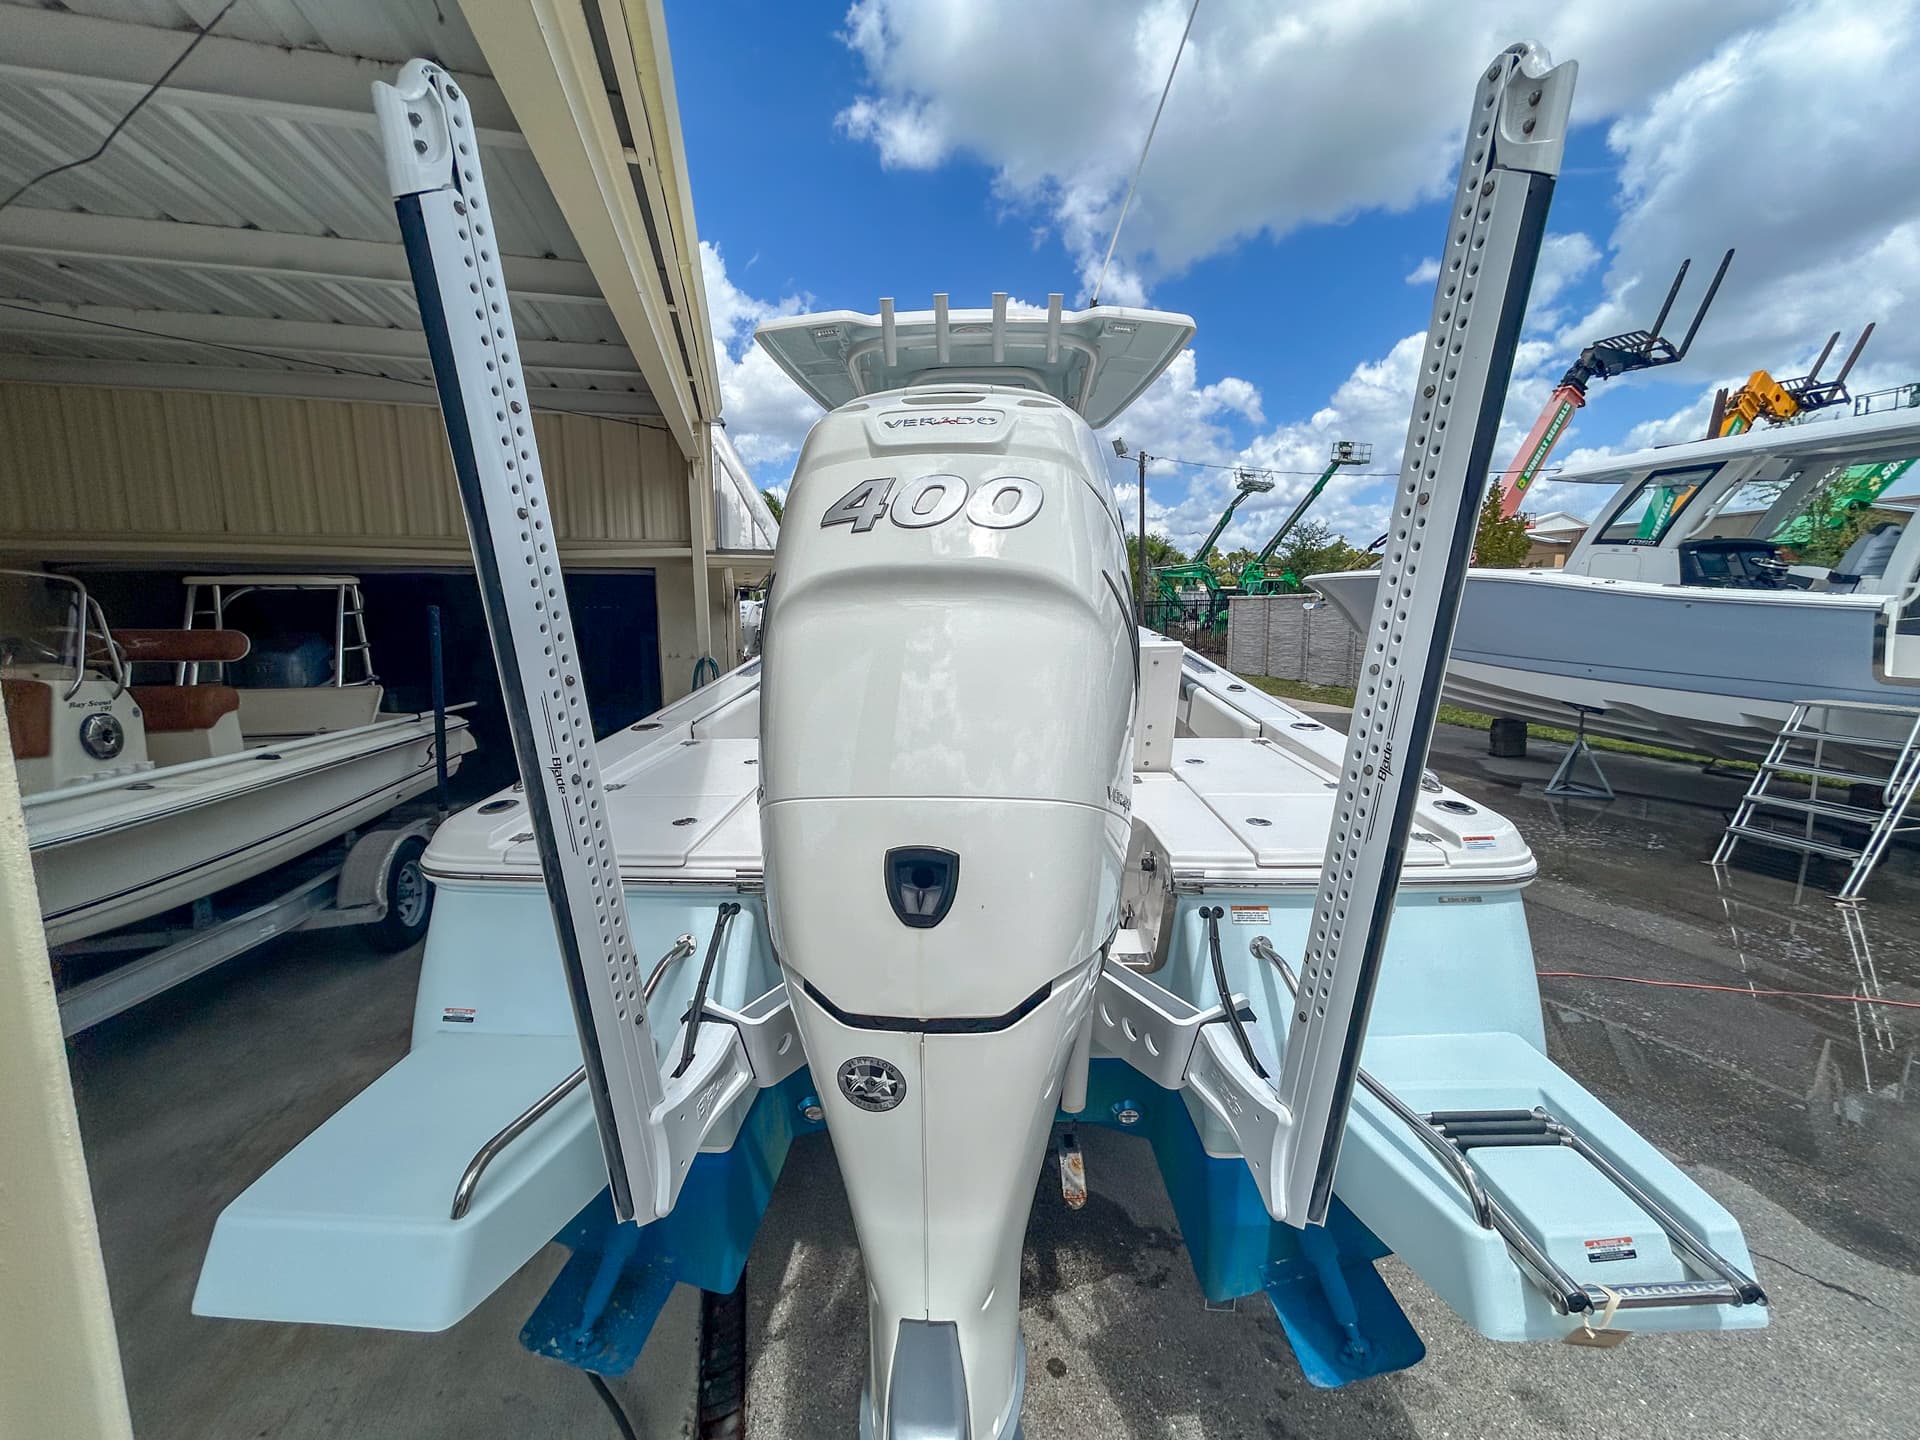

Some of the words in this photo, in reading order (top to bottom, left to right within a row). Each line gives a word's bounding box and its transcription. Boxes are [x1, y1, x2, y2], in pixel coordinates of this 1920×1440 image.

[883, 416, 998, 429] VERADO
[1524, 440, 1549, 478] SUNBELT
[1546, 402, 1571, 441] RENTALS
[820, 473, 1045, 533] 400
[1651, 495, 1674, 538] RENTALS
[546, 757, 567, 795] Blade
[1377, 742, 1395, 783] Blade
[847, 1058, 868, 1069] VERY
[876, 1060, 896, 1073] LOW
